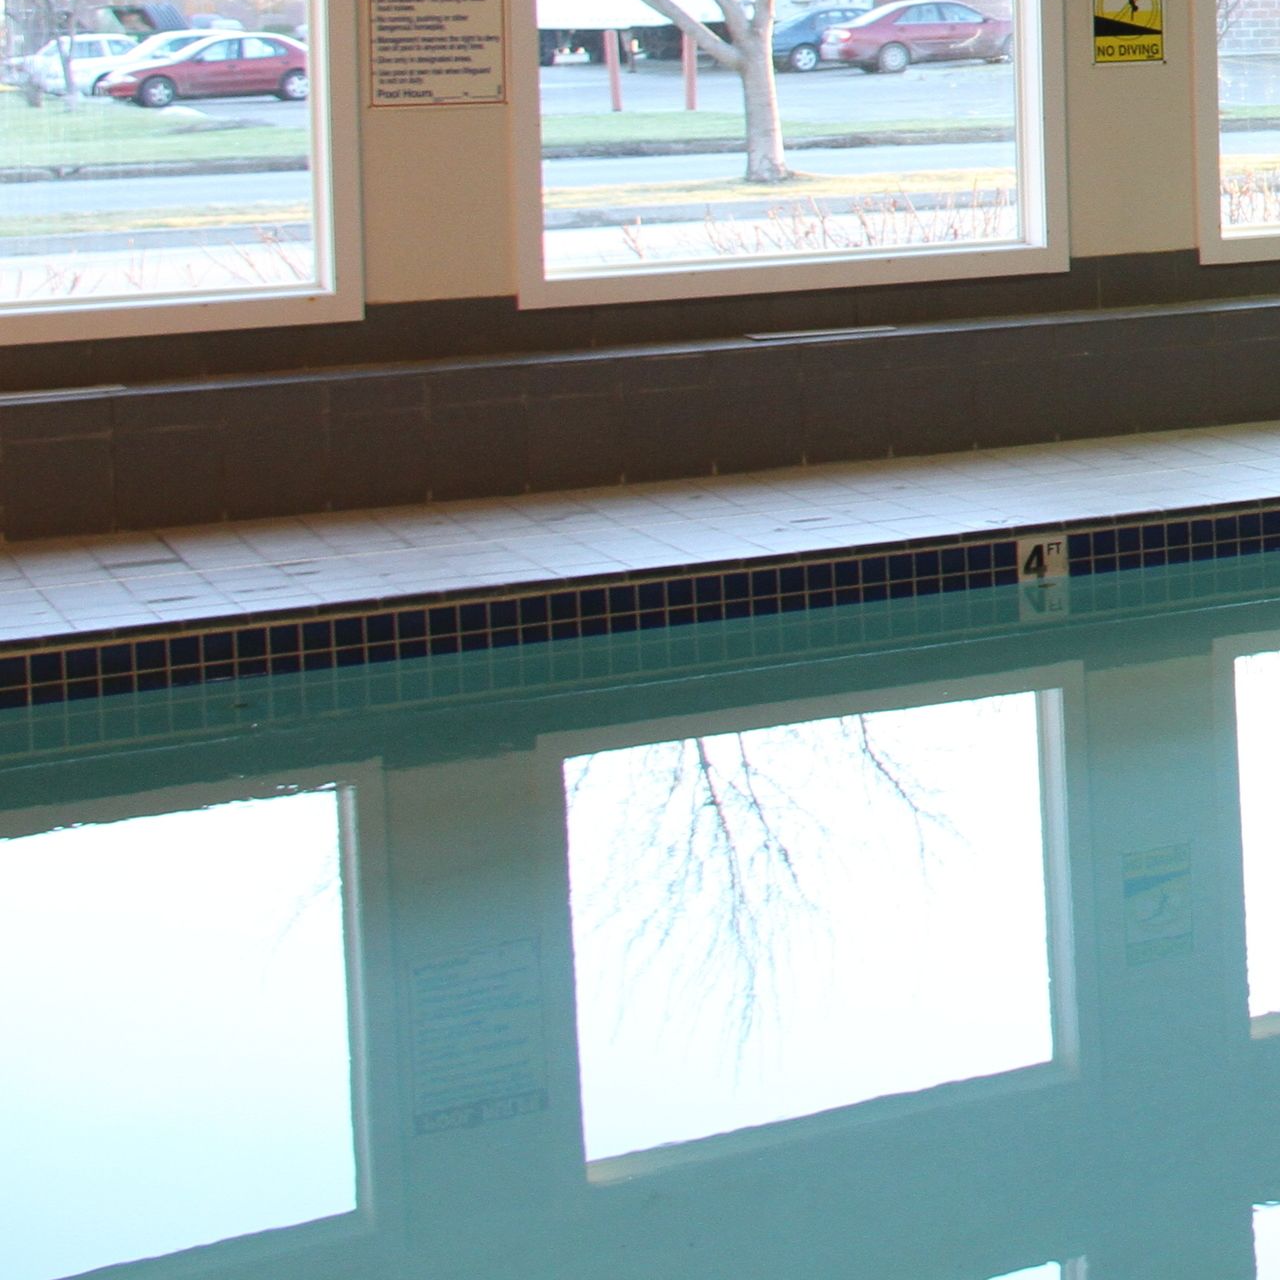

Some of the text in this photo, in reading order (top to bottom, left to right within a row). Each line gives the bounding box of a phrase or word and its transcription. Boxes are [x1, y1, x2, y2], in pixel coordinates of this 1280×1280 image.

[1097, 43, 1159, 57] NO DIVING
[377, 89, 400, 98] Pool
[403, 89, 434, 98] Hours
[1023, 542, 1062, 579] 4 FT
